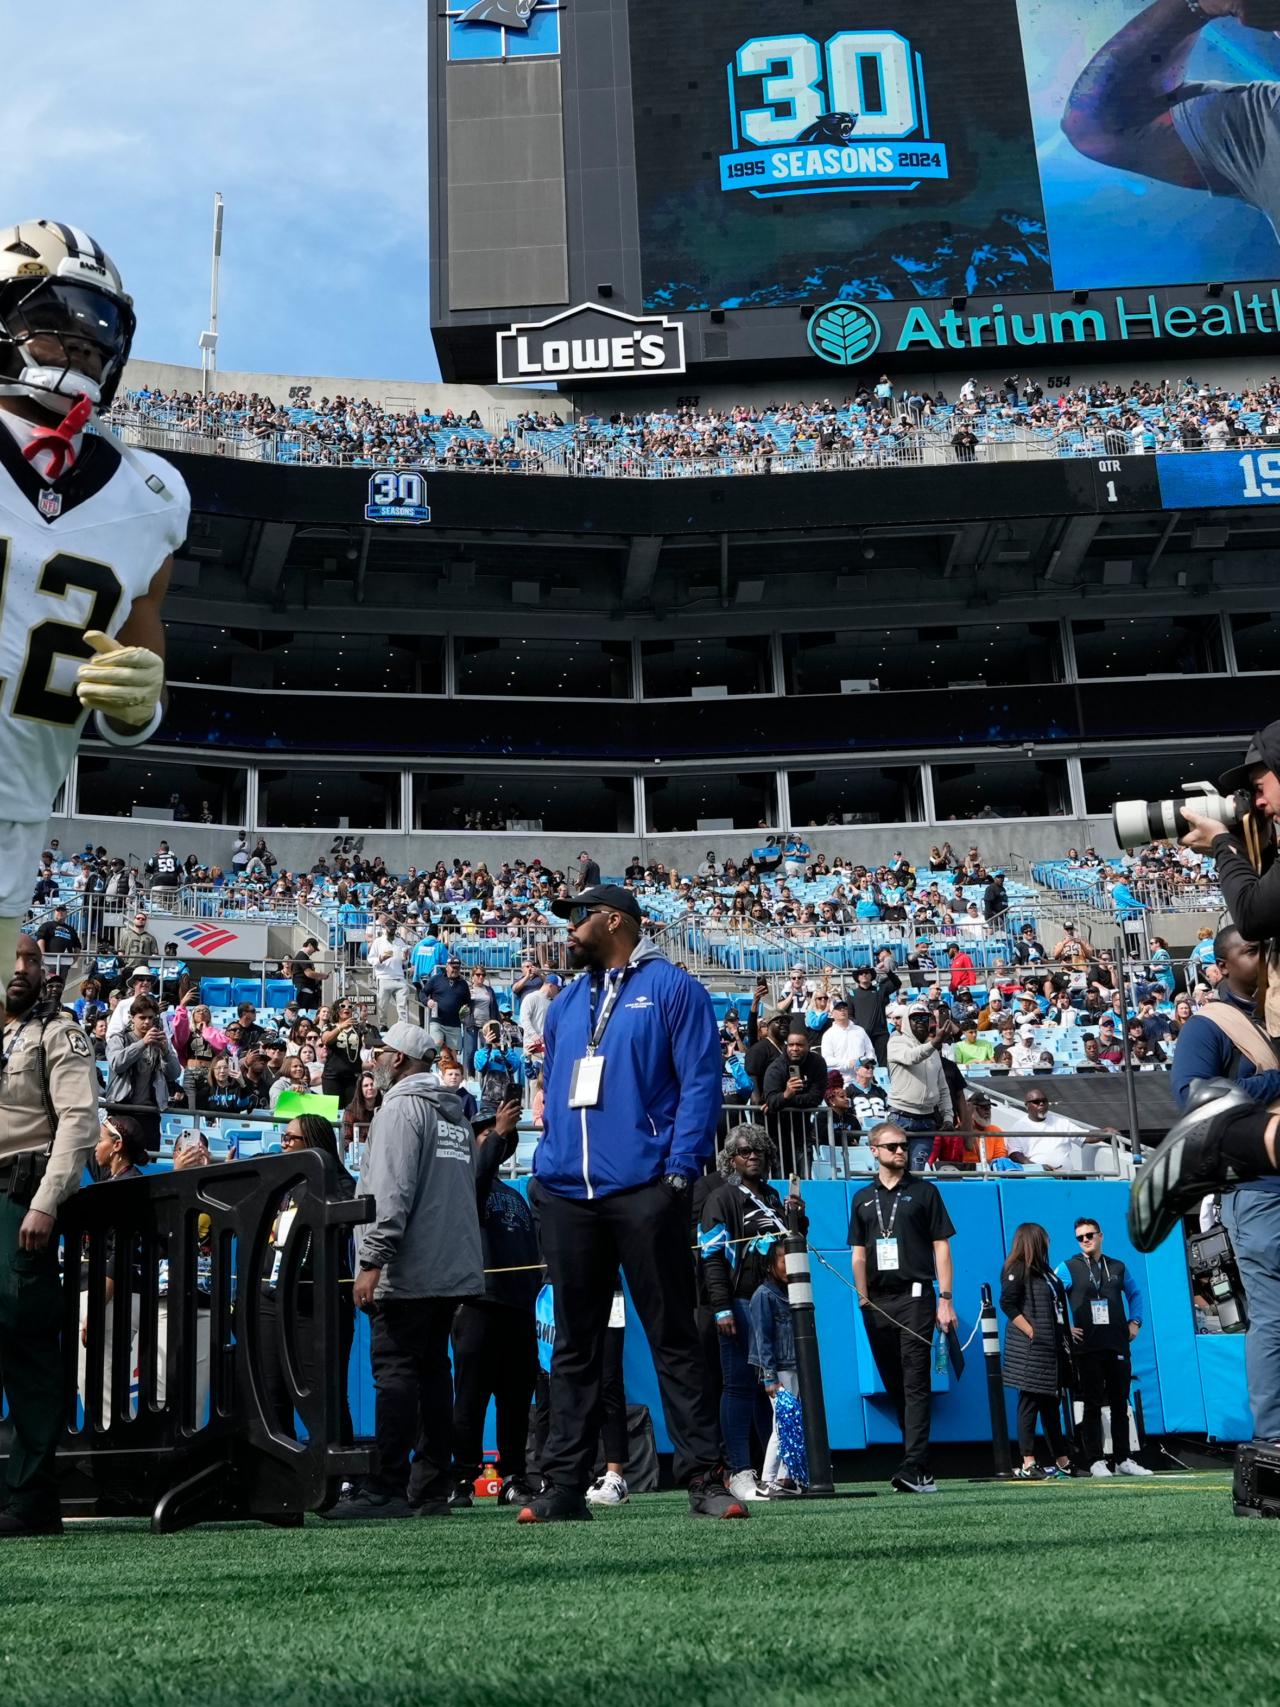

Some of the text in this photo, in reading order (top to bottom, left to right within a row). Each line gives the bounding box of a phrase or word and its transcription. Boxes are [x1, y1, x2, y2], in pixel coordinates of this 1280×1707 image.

[736, 29, 918, 146] 30
[727, 147, 942, 179] 1995 SEASONS 2024
[896, 304, 1106, 351] Atrium
[517, 330, 666, 373] LOWE'S
[1047, 375, 1071, 389] 554
[1098, 460, 1121, 472] QTR
[375, 474, 421, 505] 30
[1107, 481, 1118, 502] 1
[381, 506, 415, 516] SEASONS
[330, 836, 365, 854] 254
